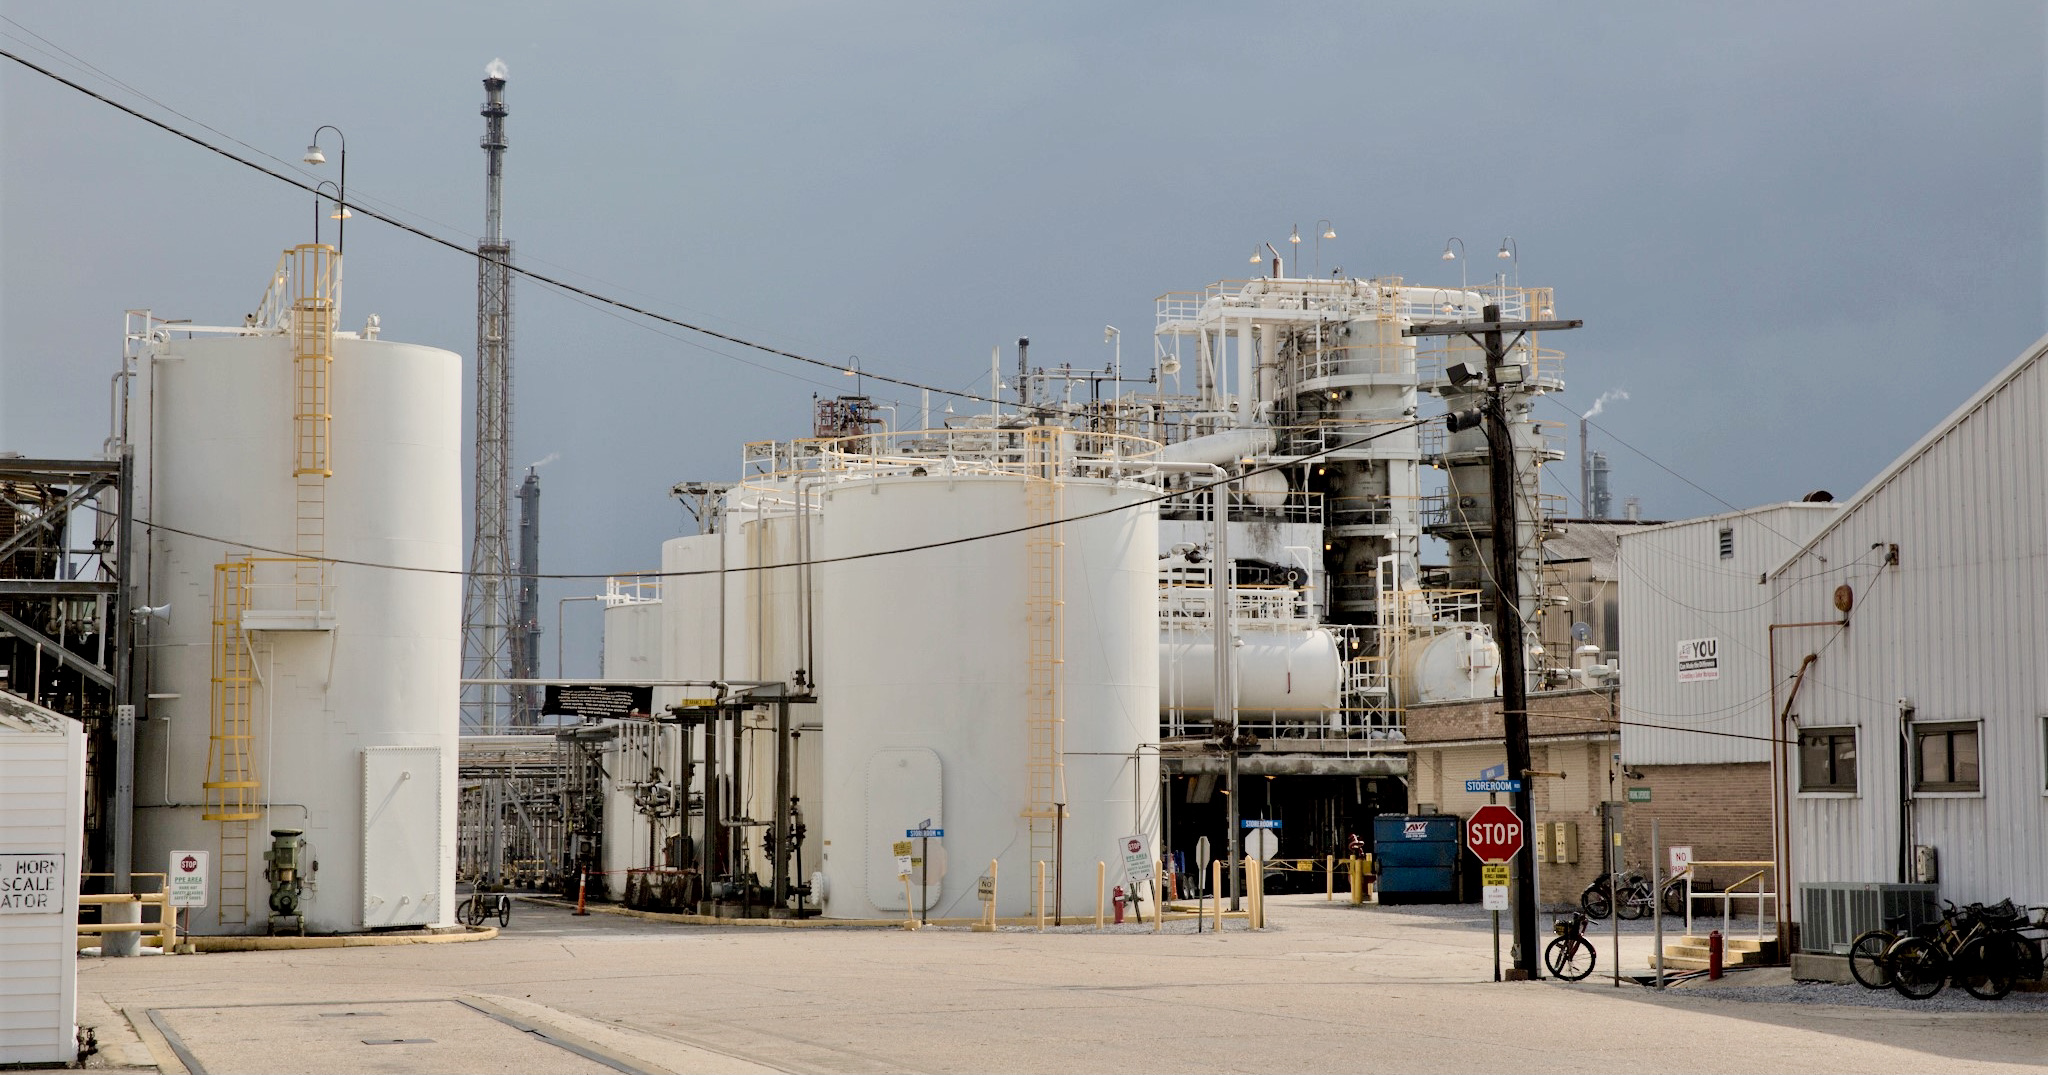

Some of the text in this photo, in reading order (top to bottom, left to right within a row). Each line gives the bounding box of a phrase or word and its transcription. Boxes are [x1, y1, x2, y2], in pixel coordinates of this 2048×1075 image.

[1692, 640, 1716, 658] YOU
[1467, 781, 1512, 791] STOREROOM
[1471, 823, 1519, 845] STOP
[1675, 852, 1686, 862] NO
[16, 860, 57, 874] HORN
[1, 876, 55, 892] SCALE
[0, 893, 48, 908] ATOR
